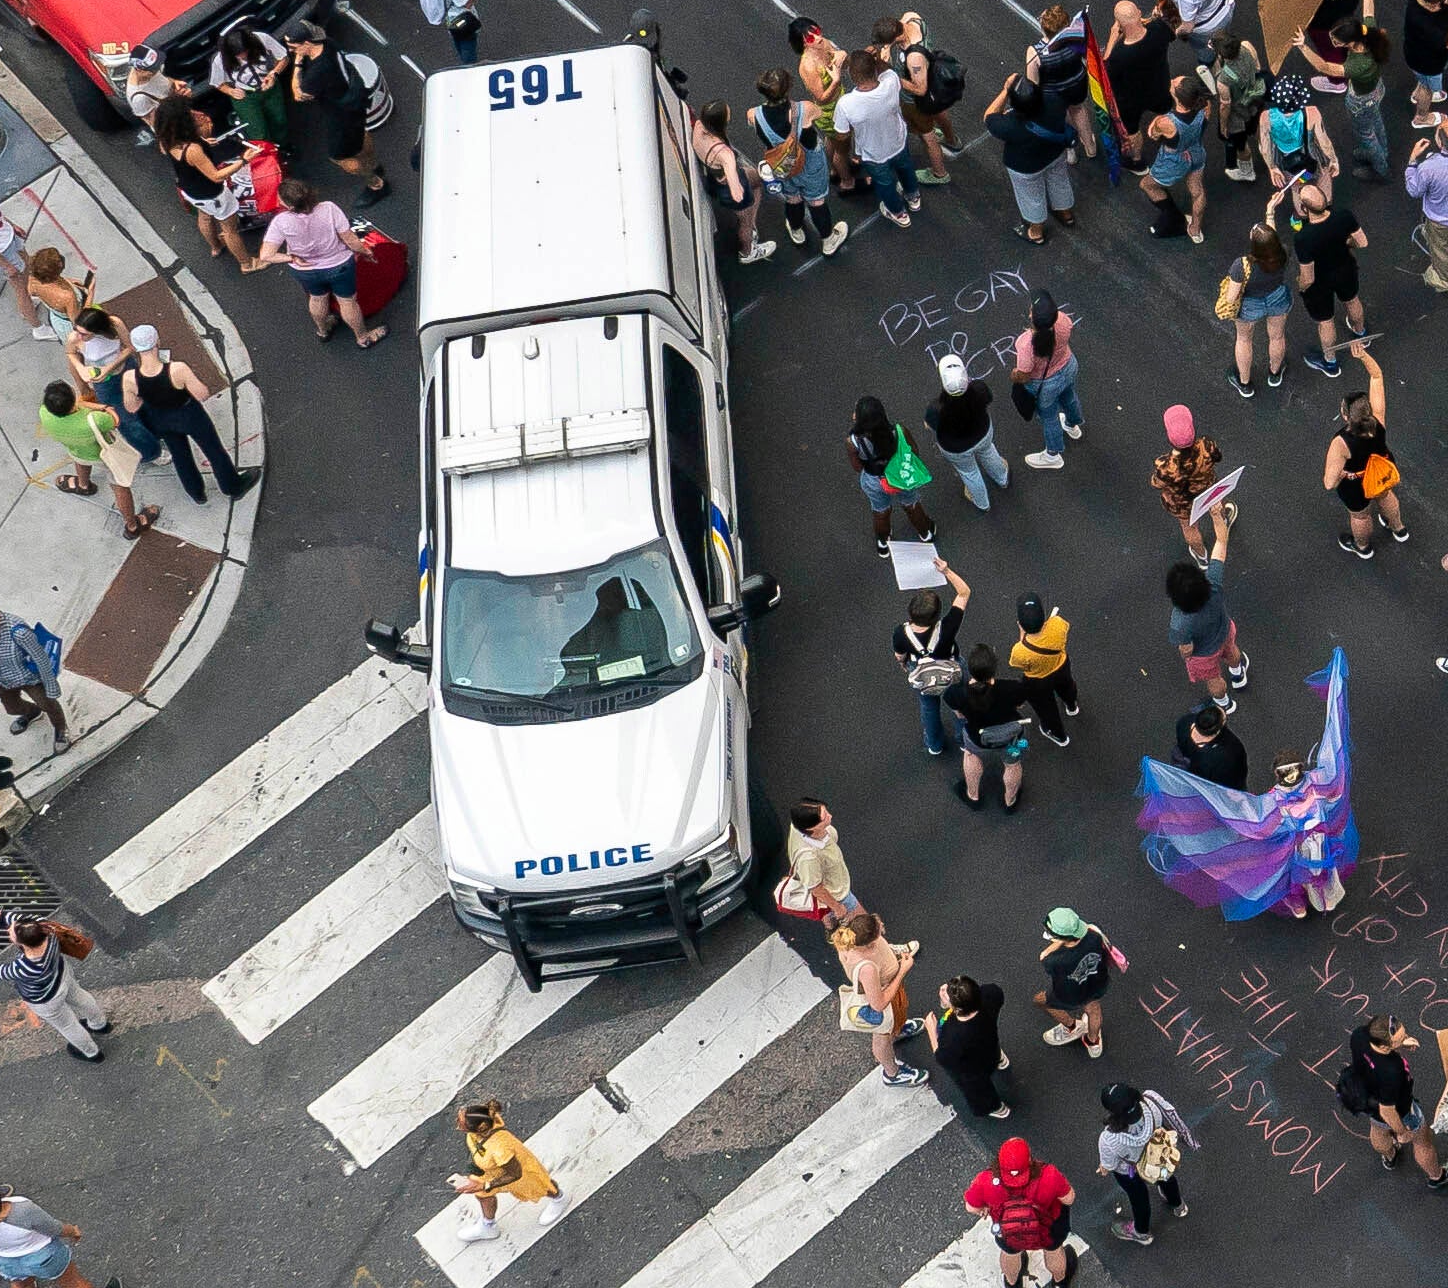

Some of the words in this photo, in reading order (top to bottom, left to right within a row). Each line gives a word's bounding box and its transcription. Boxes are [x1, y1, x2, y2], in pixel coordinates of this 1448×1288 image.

[489, 60, 583, 112] T65
[878, 295, 950, 347] BE
[955, 266, 1031, 313] GAY
[515, 842, 654, 880] POLICE
[1138, 977, 1234, 1075] HATE
[1220, 966, 1298, 1057] THE
[1231, 1080, 1347, 1196] MOMS
